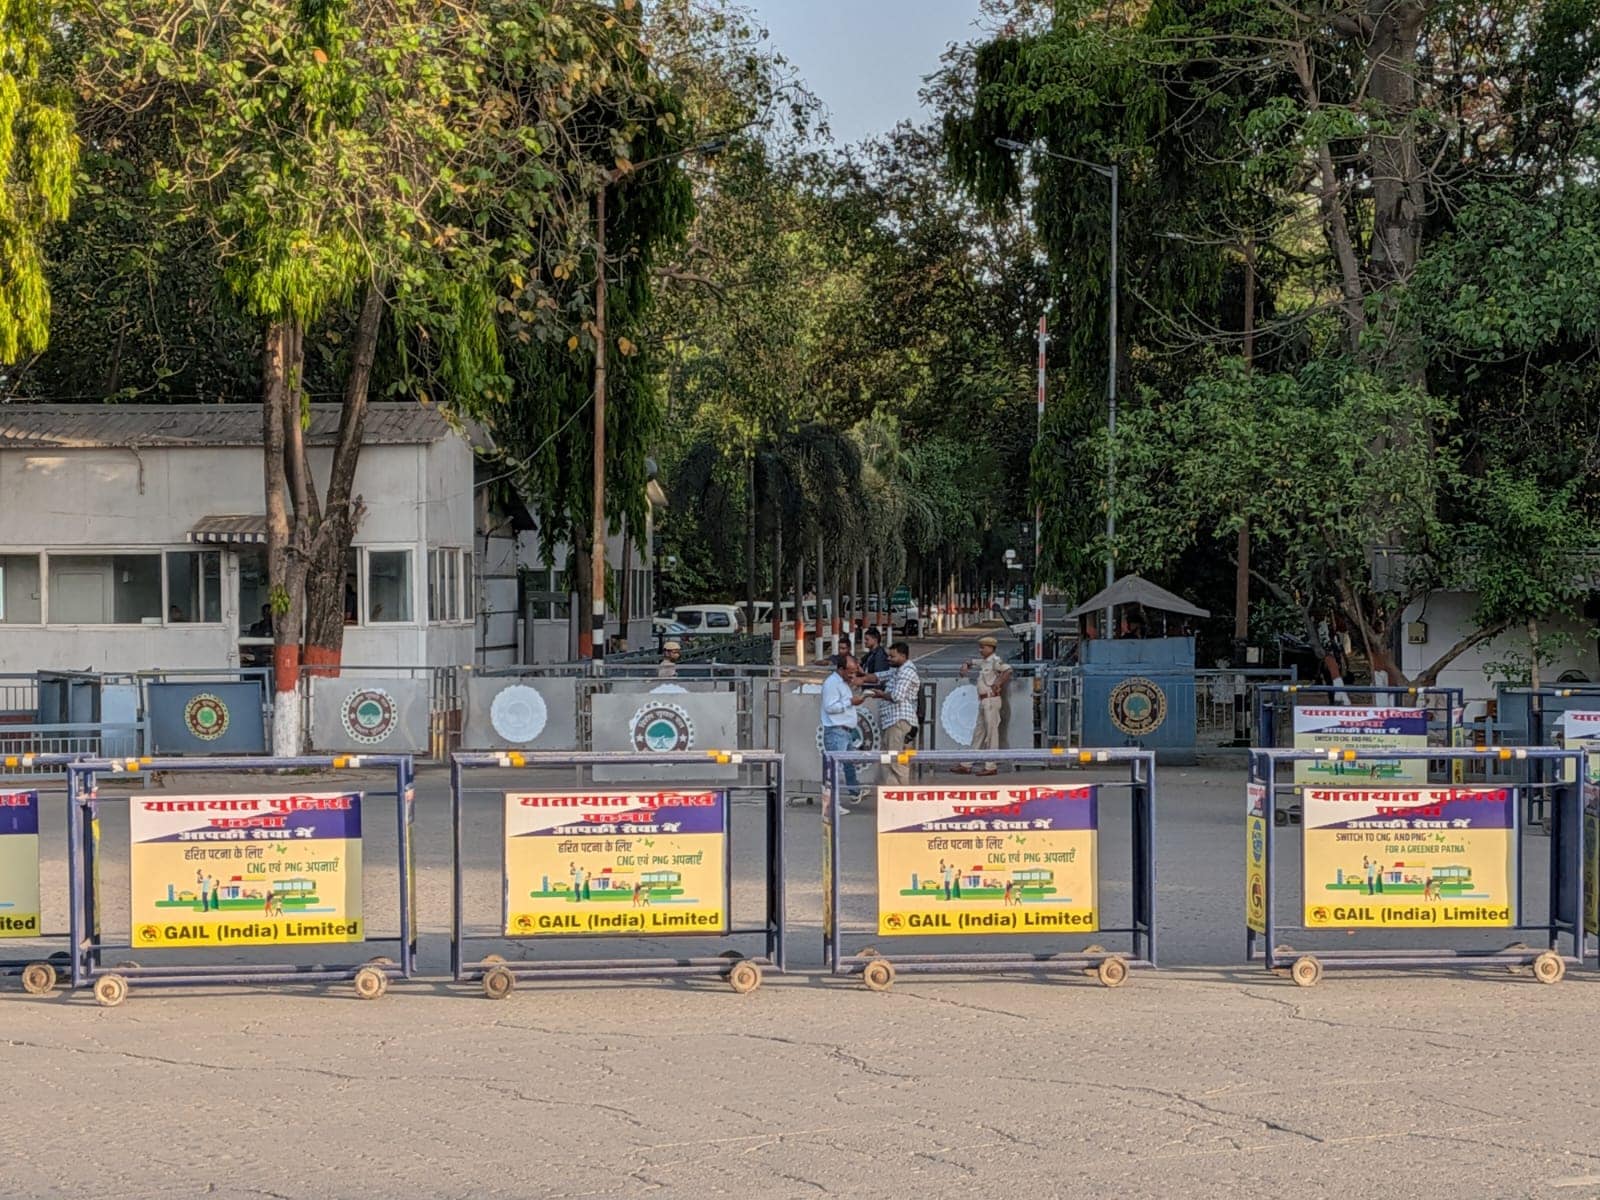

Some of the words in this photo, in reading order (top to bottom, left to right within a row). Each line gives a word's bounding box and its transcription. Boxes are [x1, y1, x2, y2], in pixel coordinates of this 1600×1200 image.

[518, 796, 630, 807] यातायात
[883, 790, 1000, 801] यातायात
[1310, 791, 1420, 802] यातायात
[142, 800, 260, 812] यातायात
[927, 837, 948, 850] हरित
[950, 838, 973, 849] पटना
[975, 836, 983, 849] के
[985, 836, 1003, 849] लिए
[1336, 833, 1363, 842] SWITCH
[1365, 833, 1374, 842] TO
[1376, 833, 1390, 842] CNG
[1394, 833, 1410, 842] AND
[1411, 833, 1426, 842] PNG
[558, 840, 579, 853] हरित
[581, 842, 602, 852] पटना
[605, 840, 613, 852] के
[615, 840, 632, 852] लिए
[1385, 845, 1397, 853] FOR
[1398, 845, 1405, 853] A
[1406, 845, 1440, 853] GREENER
[1441, 845, 1465, 853] PATNA
[184, 846, 206, 861] हरित
[208, 848, 232, 860] पटना
[234, 846, 242, 858] के
[244, 846, 264, 858] लिए
[987, 853, 1006, 864] CNG
[1008, 851, 1020, 863] एवं
[1023, 853, 1041, 863] PNG
[617, 856, 635, 866] CNG
[638, 854, 649, 865] एवं
[652, 856, 668, 864] PNG
[246, 863, 266, 873] CNG
[268, 861, 282, 872] एवं
[284, 863, 302, 872] PNG
[539, 915, 581, 928] GAIL
[588, 914, 645, 929] (India)
[652, 912, 719, 926] Limited
[908, 914, 951, 927] GAIL
[958, 913, 1017, 929] (India)
[1024, 911, 1093, 926] Limited
[1333, 908, 1374, 921] GAIL
[1381, 907, 1437, 923] (India)
[1443, 908, 1509, 920] Limited
[164, 926, 210, 940] GAIL
[217, 924, 278, 941] (India)
[286, 922, 358, 937] Limited
